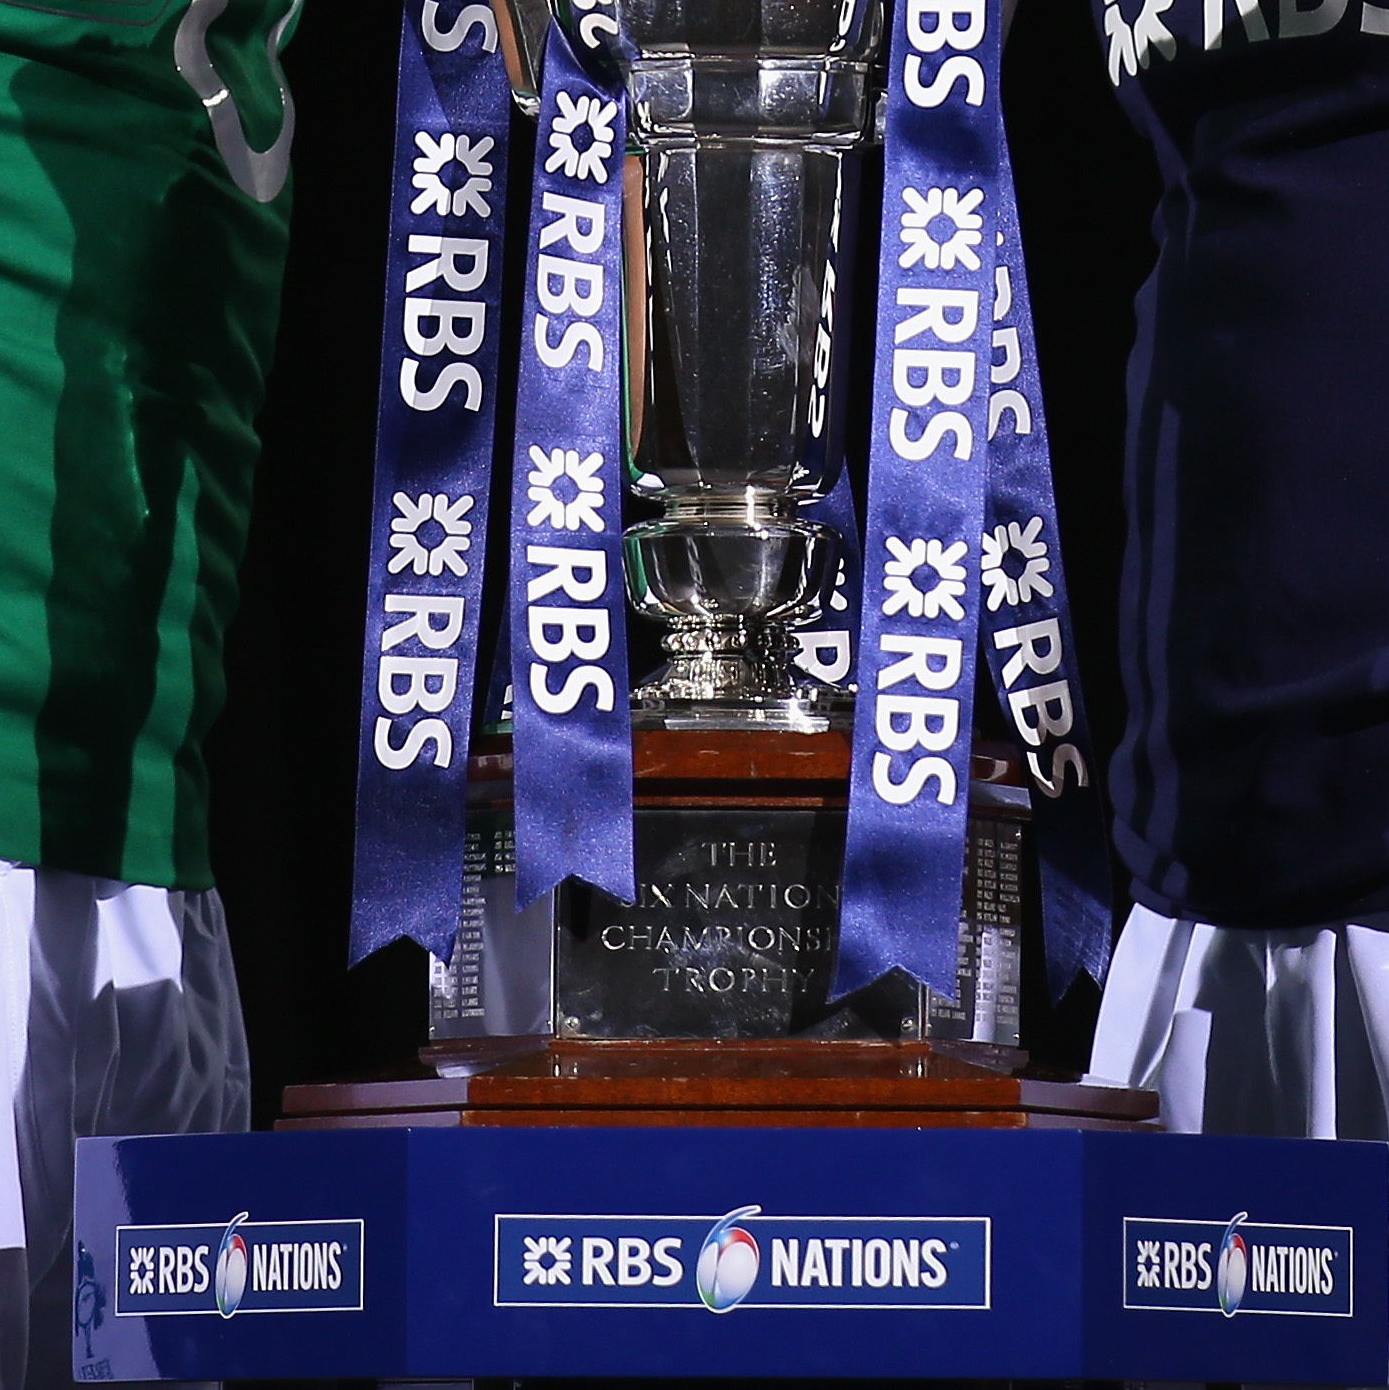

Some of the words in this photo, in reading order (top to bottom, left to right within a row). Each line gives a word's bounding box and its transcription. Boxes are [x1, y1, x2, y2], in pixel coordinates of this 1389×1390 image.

[399, 234, 489, 413] RBS
[536, 191, 606, 373] RBS
[891, 287, 979, 462] RBS
[374, 593, 465, 770] RBS
[526, 544, 614, 715] RBS
[993, 617, 1090, 799] RBS
[871, 629, 963, 806] RBS
[621, 883, 674, 909] IX
[701, 841, 777, 867] THE
[653, 966, 815, 993] TROPHY
[158, 1245, 210, 1294] RBS
[252, 1241, 342, 1292] NATIONS
[582, 1237, 683, 1287] RBS
[771, 1238, 947, 1288] NATIONS
[1164, 1241, 1212, 1290] RBS
[1252, 1244, 1333, 1295] NATIONS
